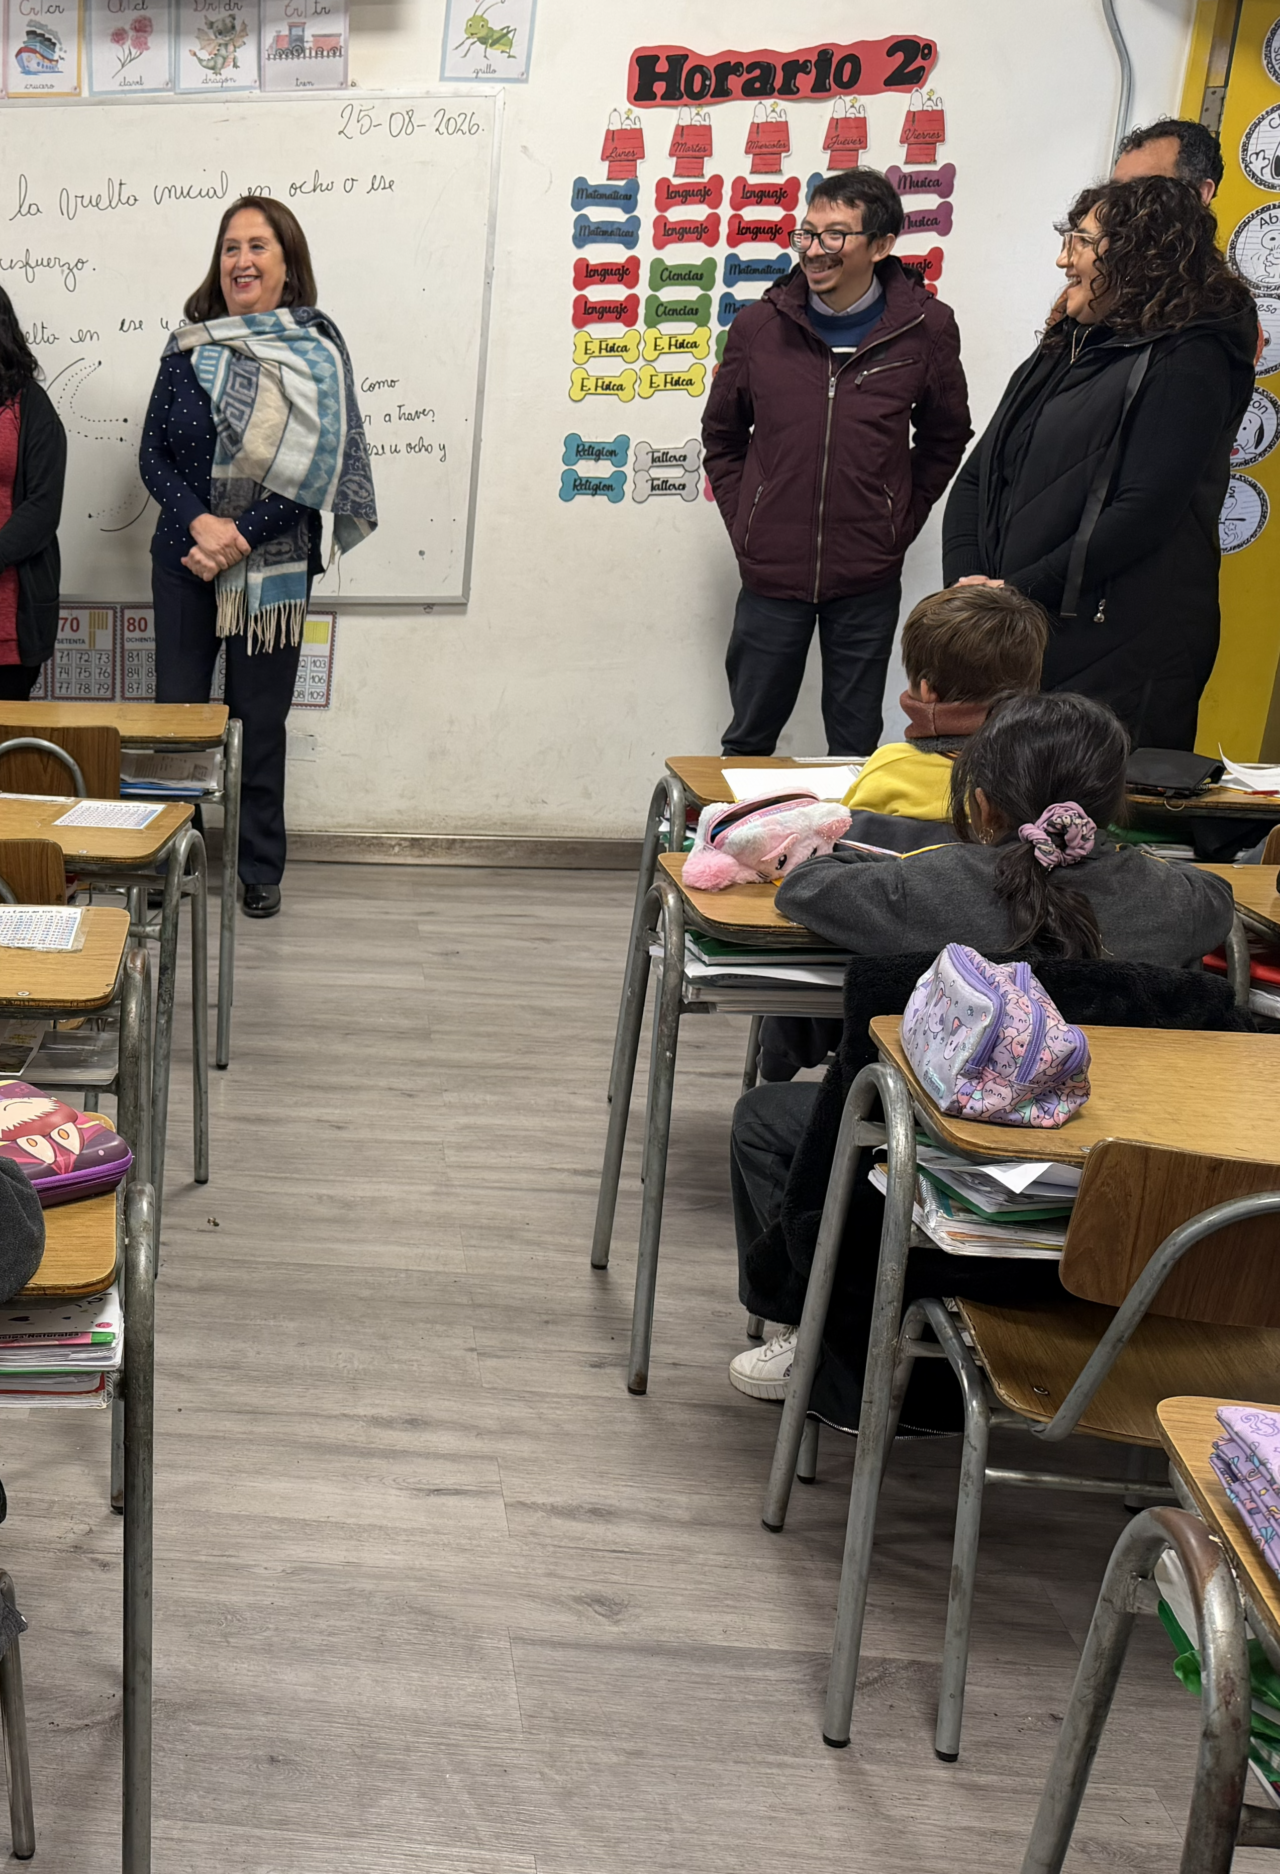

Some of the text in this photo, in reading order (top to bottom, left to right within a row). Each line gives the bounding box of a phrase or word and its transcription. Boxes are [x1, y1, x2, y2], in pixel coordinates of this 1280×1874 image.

[44, 3, 65, 14] cr
[472, 64, 497, 78] grillo
[634, 49, 861, 103] Horario
[118, 76, 144, 87] clavel
[295, 78, 315, 88] tren
[828, 134, 864, 150] Jueves
[904, 129, 942, 141] Viernes
[606, 147, 637, 160] Lunes
[673, 141, 708, 153] Martes
[898, 174, 942, 190] Musica
[9, 173, 42, 222] la
[288, 170, 334, 195] ocho
[576, 188, 632, 201] Matematicas
[665, 185, 712, 204] Lenguaje
[740, 184, 788, 204] Lenguaje
[579, 225, 634, 237] Matematicas
[662, 222, 709, 241] Lenguaje
[737, 222, 784, 241] Lenguaje
[584, 264, 630, 282] Lenguaje
[660, 268, 704, 282] Ciencias
[729, 264, 785, 276] Matematicas
[583, 302, 628, 320] Lenguaje
[655, 303, 699, 317] Ciencias
[70, 329, 100, 343] en
[119, 318, 143, 332] ese
[584, 340, 630, 355] E Fisica
[653, 337, 700, 351] E Fisica
[580, 378, 626, 392] E Fisica
[649, 373, 695, 388] E Fisica
[384, 413, 392, 423] a
[406, 436, 433, 454] ocho
[439, 442, 447, 462] y
[576, 444, 618, 463] Religion
[573, 479, 615, 497] Religion
[58, 617, 79, 632] 70
[126, 617, 148, 632] 80
[59, 652, 110, 663] 71 72 73
[127, 652, 140, 662] 81
[311, 660, 326, 669] 103
[59, 666, 110, 678] 74 75 76
[127, 667, 140, 678] 84
[310, 675, 326, 684] 106
[59, 682, 110, 694] 77 78 79
[127, 683, 140, 694] 87
[309, 690, 324, 700] 109
